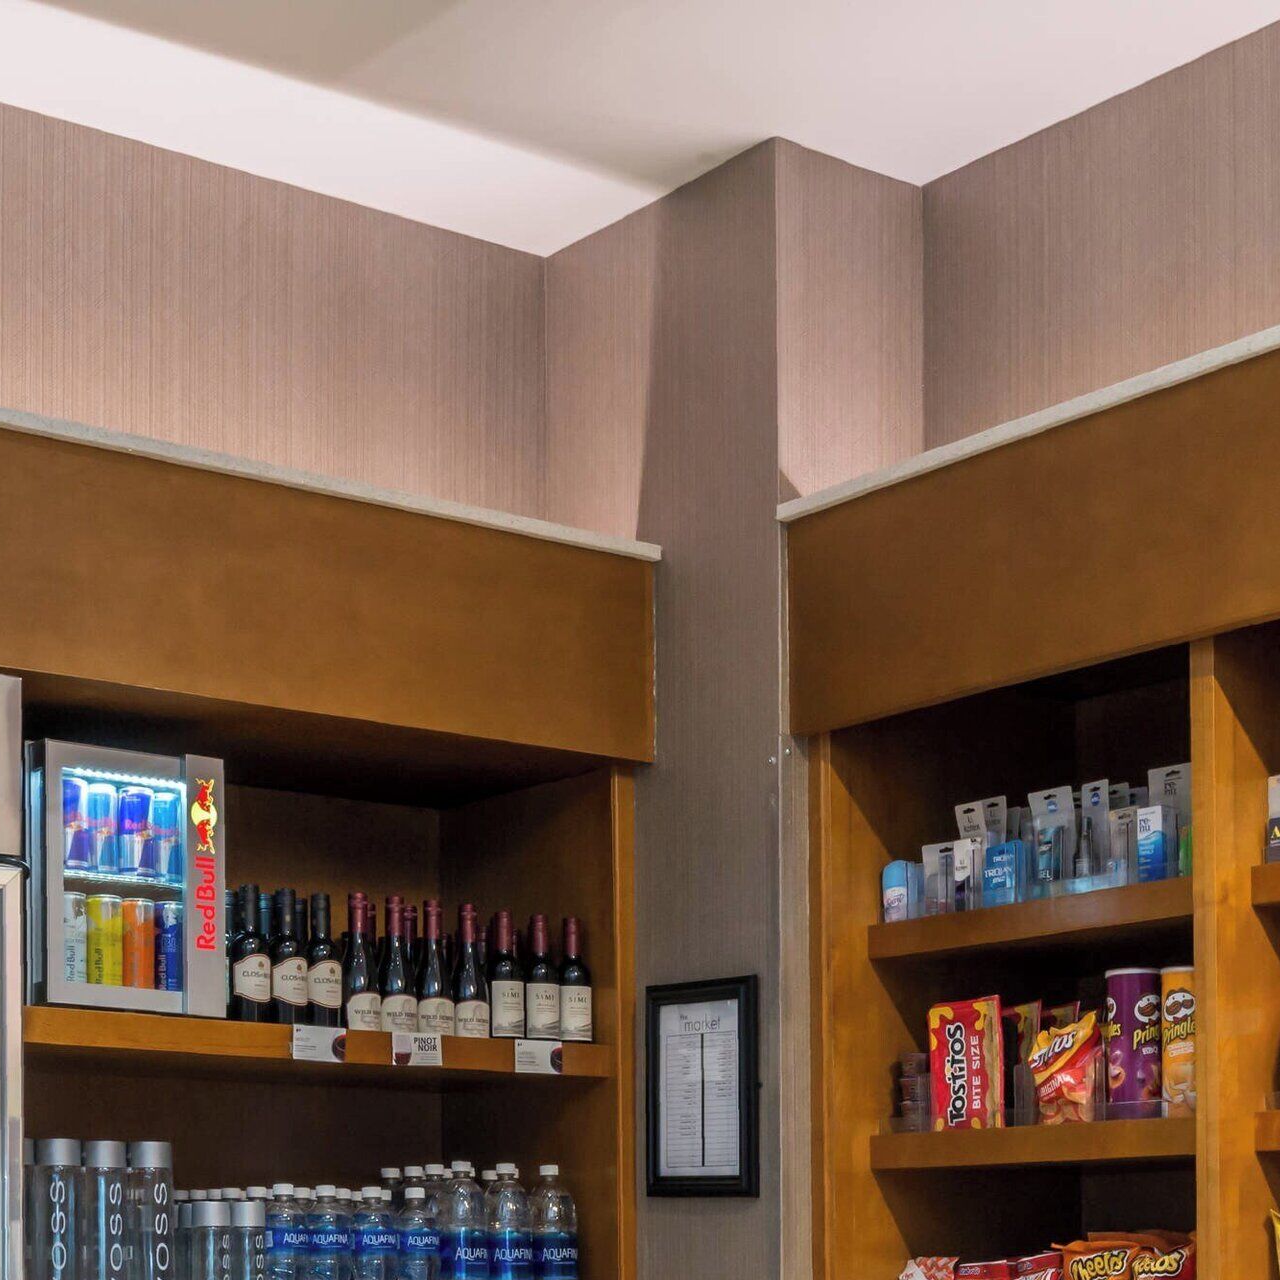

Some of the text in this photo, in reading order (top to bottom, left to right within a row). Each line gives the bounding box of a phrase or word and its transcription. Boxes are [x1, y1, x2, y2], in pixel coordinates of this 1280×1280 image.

[195, 856, 216, 951] Red Bull
[501, 990, 521, 998] SIMI
[535, 993, 556, 1001] SIMI
[568, 995, 588, 1004] SIMI
[354, 1008, 372, 1016] WILD
[683, 1016, 721, 1032] market
[413, 1036, 438, 1045] PINOT
[418, 1043, 438, 1053] NOIR
[970, 1035, 982, 1110] BITE SIZE
[311, 1233, 349, 1245] AQUAFINA
